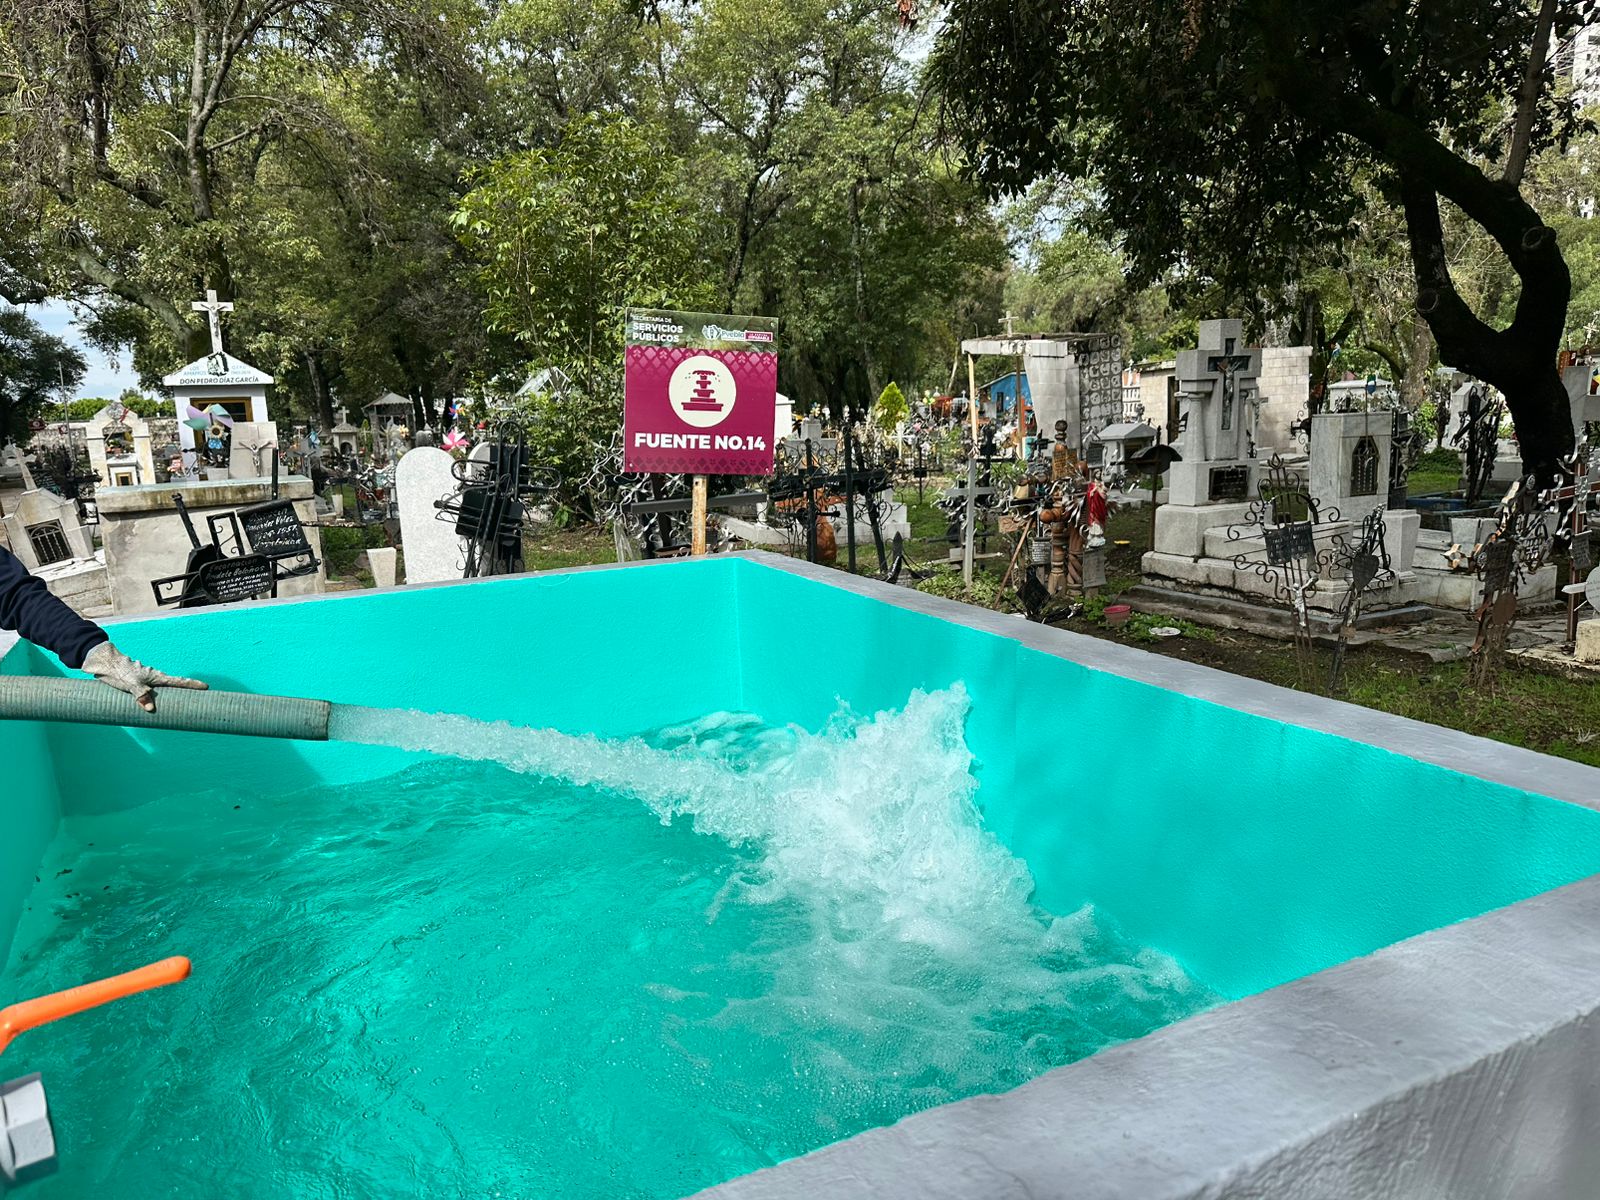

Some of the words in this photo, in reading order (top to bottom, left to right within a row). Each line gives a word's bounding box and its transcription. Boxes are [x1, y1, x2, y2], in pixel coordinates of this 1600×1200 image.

[632, 322, 684, 334] SERVICIOS
[632, 331, 680, 342] PÚBLICOS
[219, 376, 235, 384] DÍAZ
[235, 375, 259, 383] GARCÍA
[634, 432, 711, 449] FUENTE
[714, 434, 766, 451] NO.14
